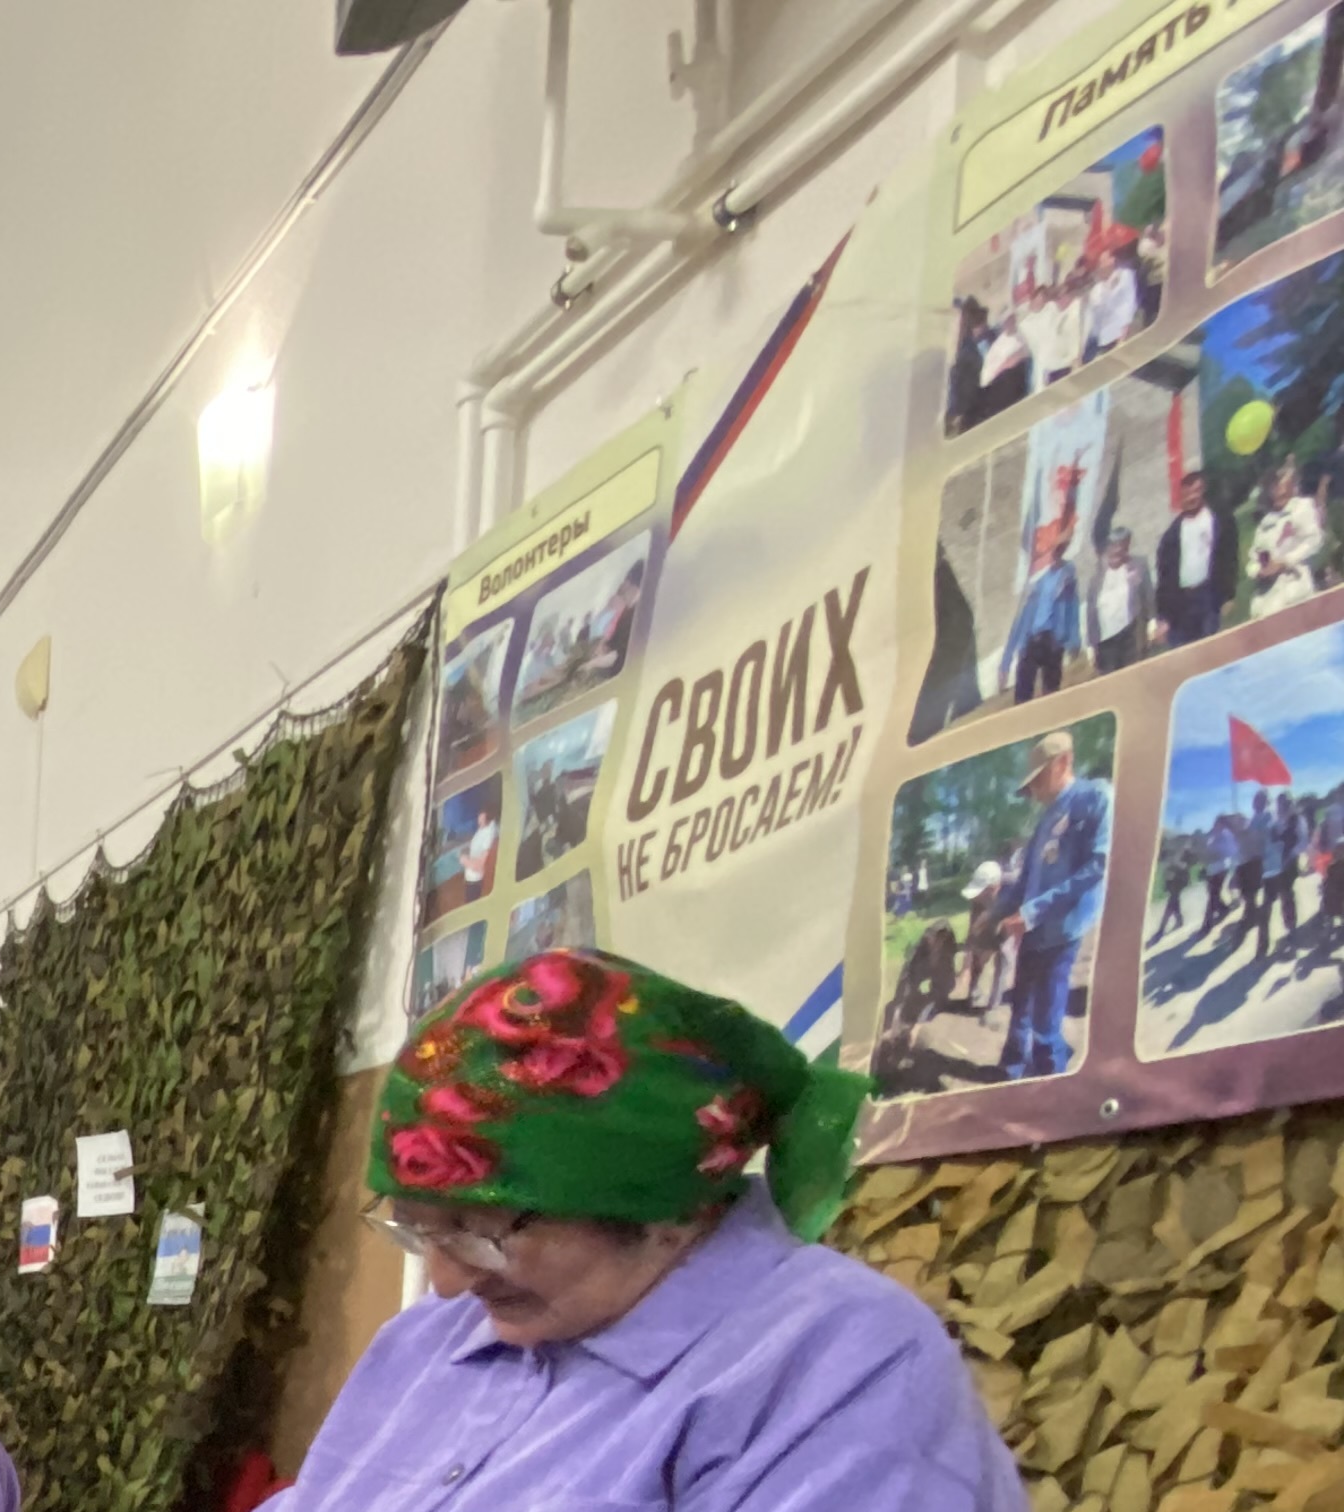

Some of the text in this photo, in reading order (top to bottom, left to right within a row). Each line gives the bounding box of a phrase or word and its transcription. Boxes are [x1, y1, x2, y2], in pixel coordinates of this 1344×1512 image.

[1038, 2, 1212, 143] Память
[478, 511, 592, 605] Волонтеры
[626, 564, 871, 823] СВОИХ
[618, 724, 863, 902] НЕ БРОСАЕМ!
